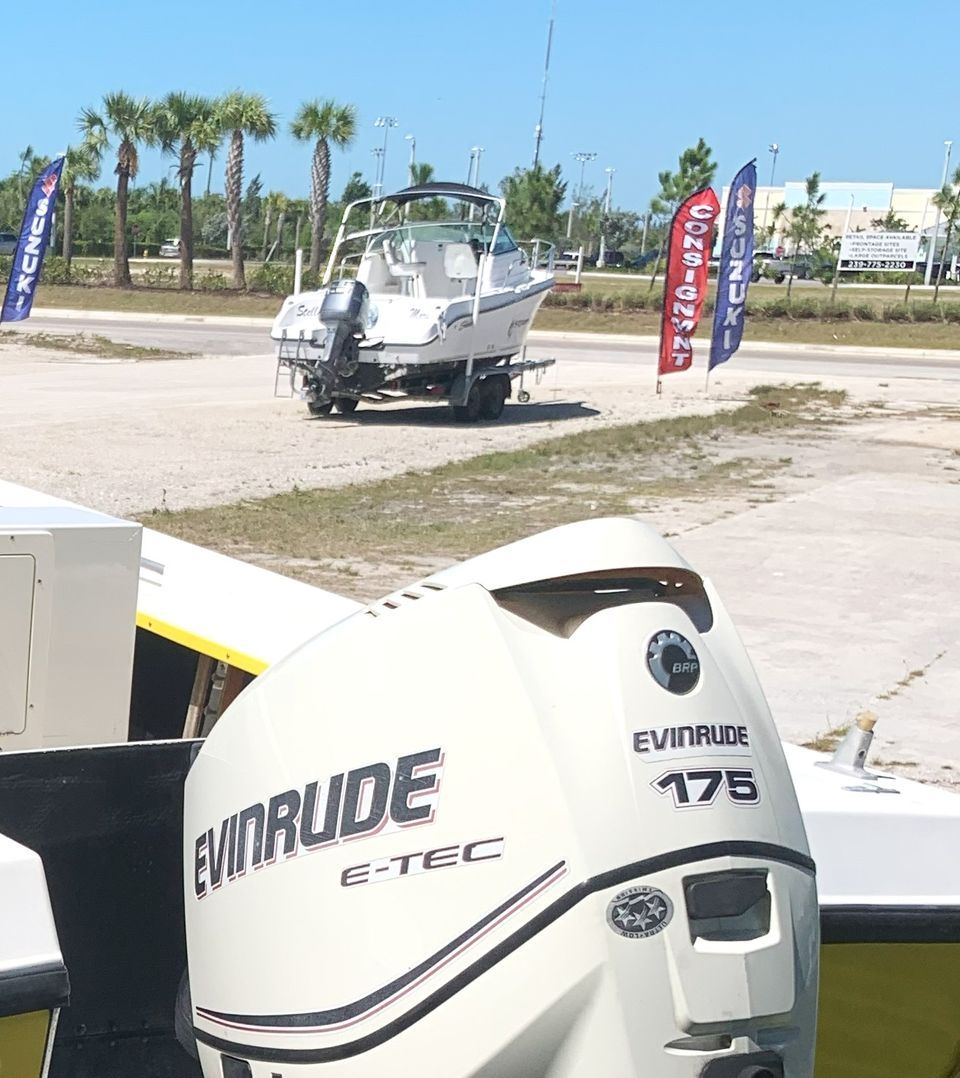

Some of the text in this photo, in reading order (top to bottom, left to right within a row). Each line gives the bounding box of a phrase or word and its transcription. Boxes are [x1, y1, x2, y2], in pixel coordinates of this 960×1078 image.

[15, 198, 49, 312] SUZUKI
[723, 214, 746, 350] SUZUKI
[672, 661, 699, 675] BRP
[633, 725, 749, 754] EVINRUDE
[658, 771, 758, 804] 175
[194, 748, 445, 900] EVINRUDE
[340, 837, 504, 888] E-TEC
